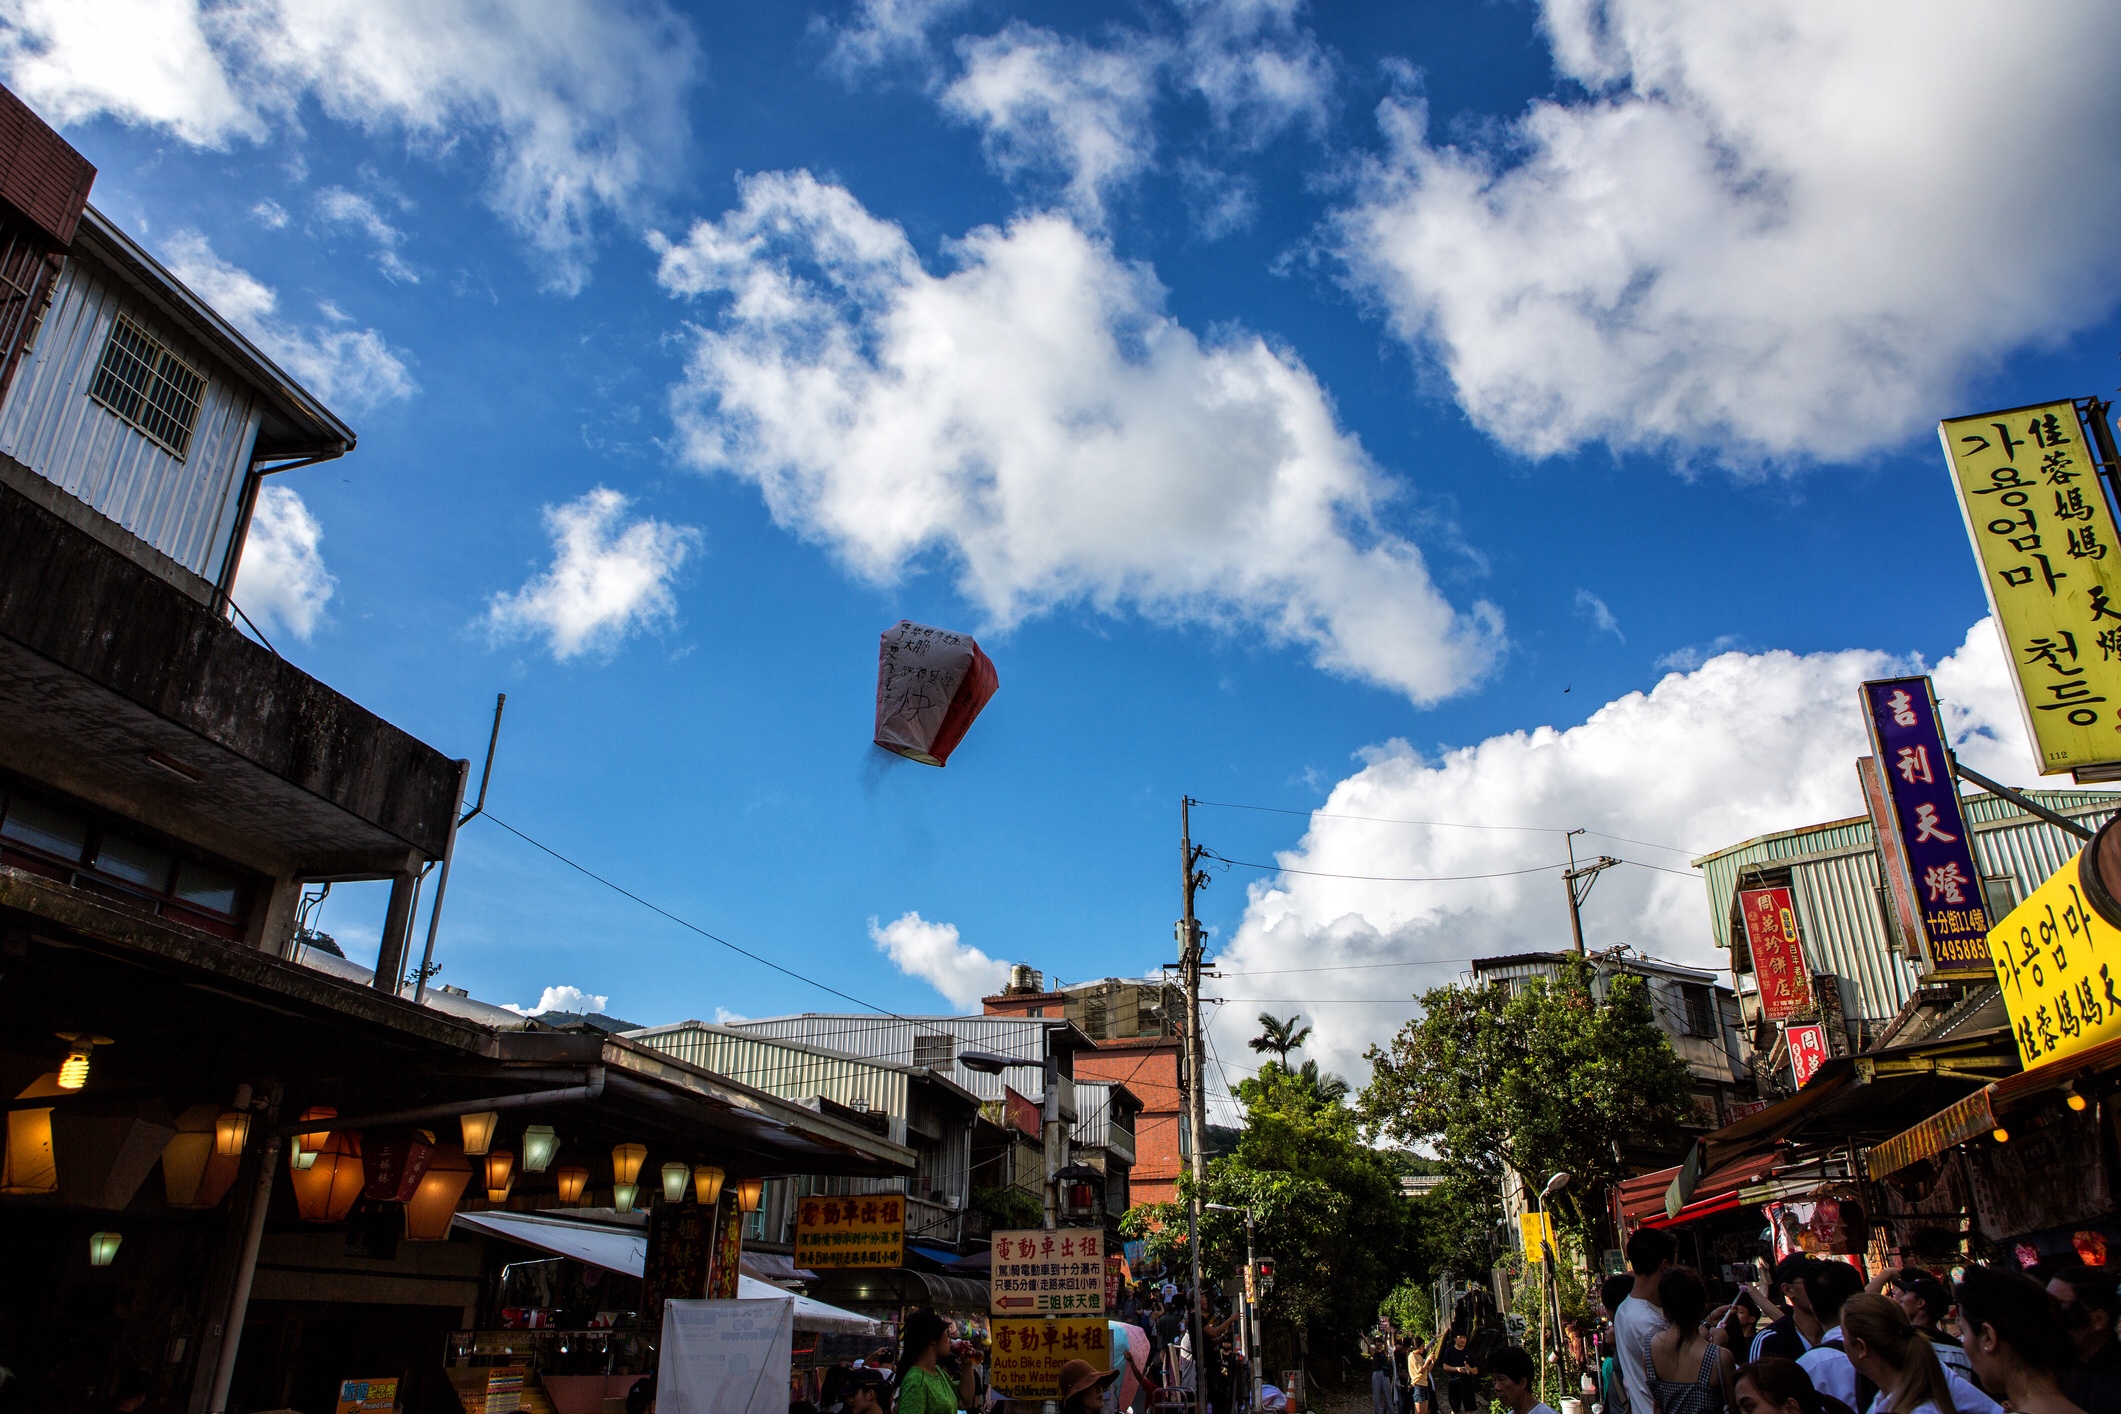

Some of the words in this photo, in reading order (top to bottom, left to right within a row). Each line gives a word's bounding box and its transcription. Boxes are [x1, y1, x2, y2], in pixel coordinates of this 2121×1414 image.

[1960, 422, 2068, 598] 가용엄마
[2023, 630, 2107, 727] 천등
[2049, 750, 2068, 761] 112
[1887, 688, 1969, 905] 吉利天燈
[1757, 894, 1791, 998] 周萬珍餅店
[1998, 883, 2094, 1002] 가용엄마
[800, 1199, 901, 1228] 電動車出租
[996, 1235, 1099, 1261] 電動車出租
[995, 1262, 1100, 1277] (駕)騎電動車到十分瀑布
[1037, 1293, 1101, 1310] 三姐妹天燈
[995, 1325, 1105, 1354] 電動車出租
[994, 1356, 1018, 1368] Auto
[1020, 1356, 1042, 1368] Bike
[1044, 1356, 1069, 1368] Rent
[994, 1371, 1007, 1383] To
[1010, 1371, 1026, 1383] the
[1029, 1371, 1060, 1383] Water
